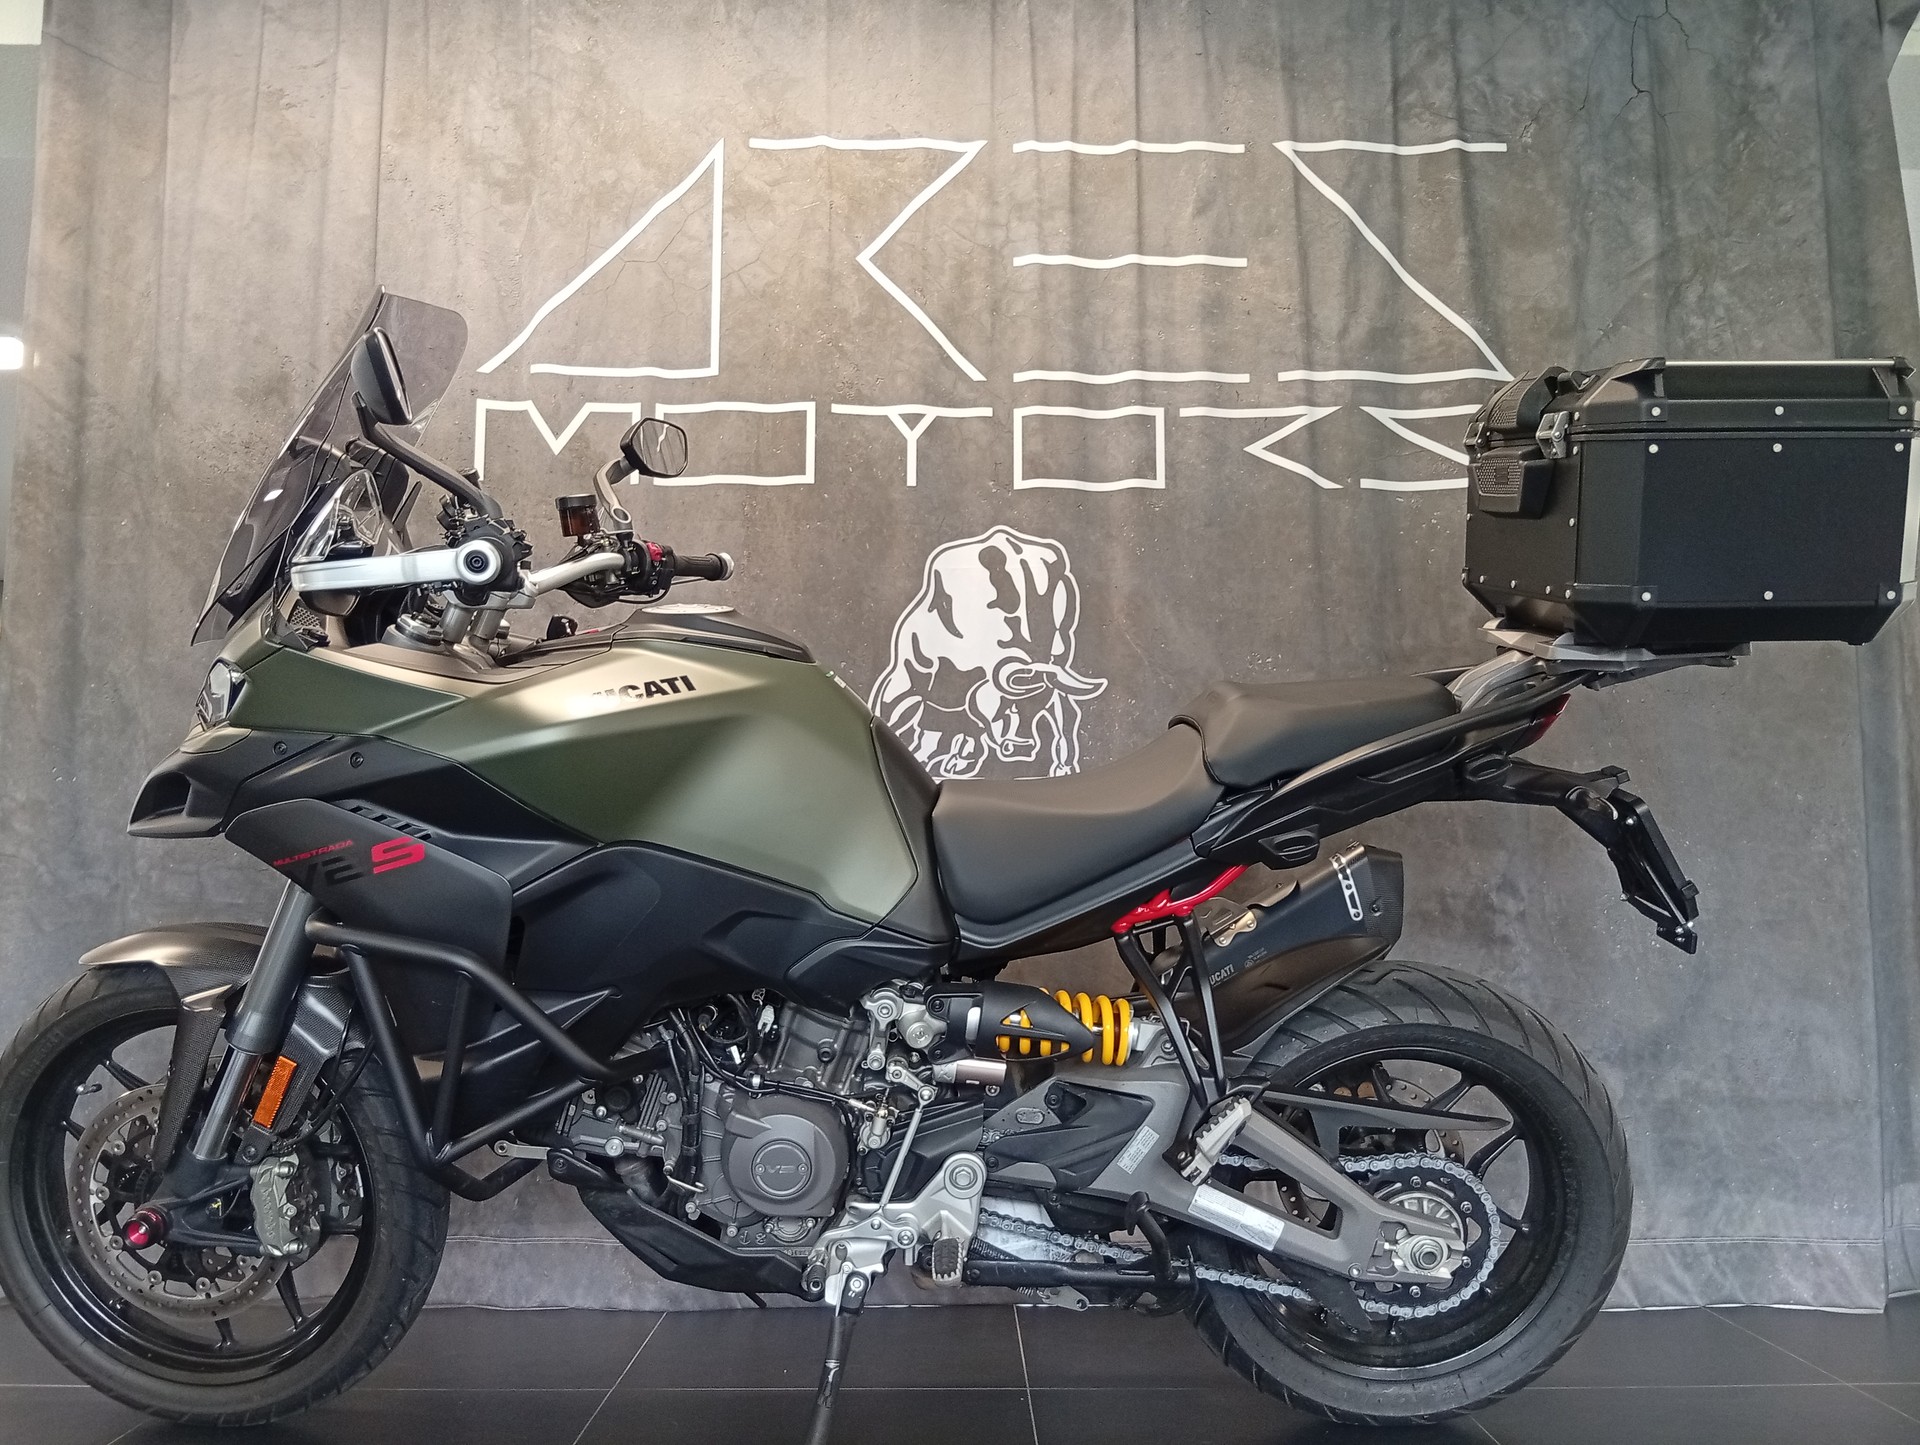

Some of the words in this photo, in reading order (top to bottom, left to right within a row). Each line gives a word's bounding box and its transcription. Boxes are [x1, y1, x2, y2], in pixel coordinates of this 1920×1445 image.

[476, 137, 1515, 382] ARES
[474, 398, 1484, 491] MOTORS
[371, 836, 425, 874] S
[1209, 963, 1236, 986] UCATI
